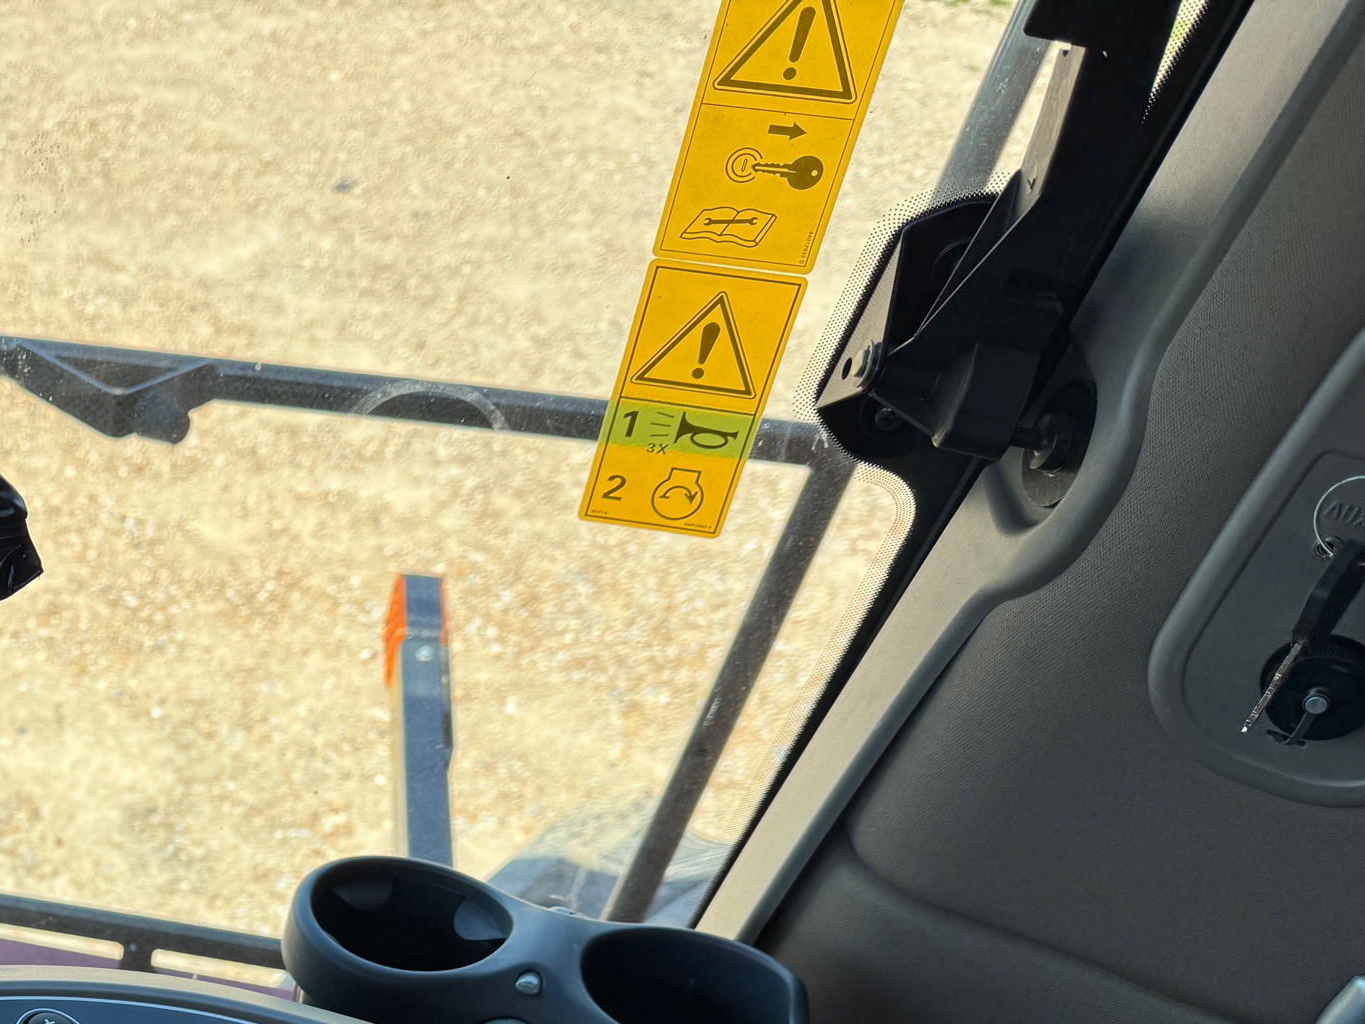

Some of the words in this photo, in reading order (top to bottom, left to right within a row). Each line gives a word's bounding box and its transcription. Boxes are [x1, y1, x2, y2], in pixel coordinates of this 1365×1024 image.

[623, 410, 639, 438] 1
[646, 442, 669, 455] 3X
[601, 474, 627, 501] 2
